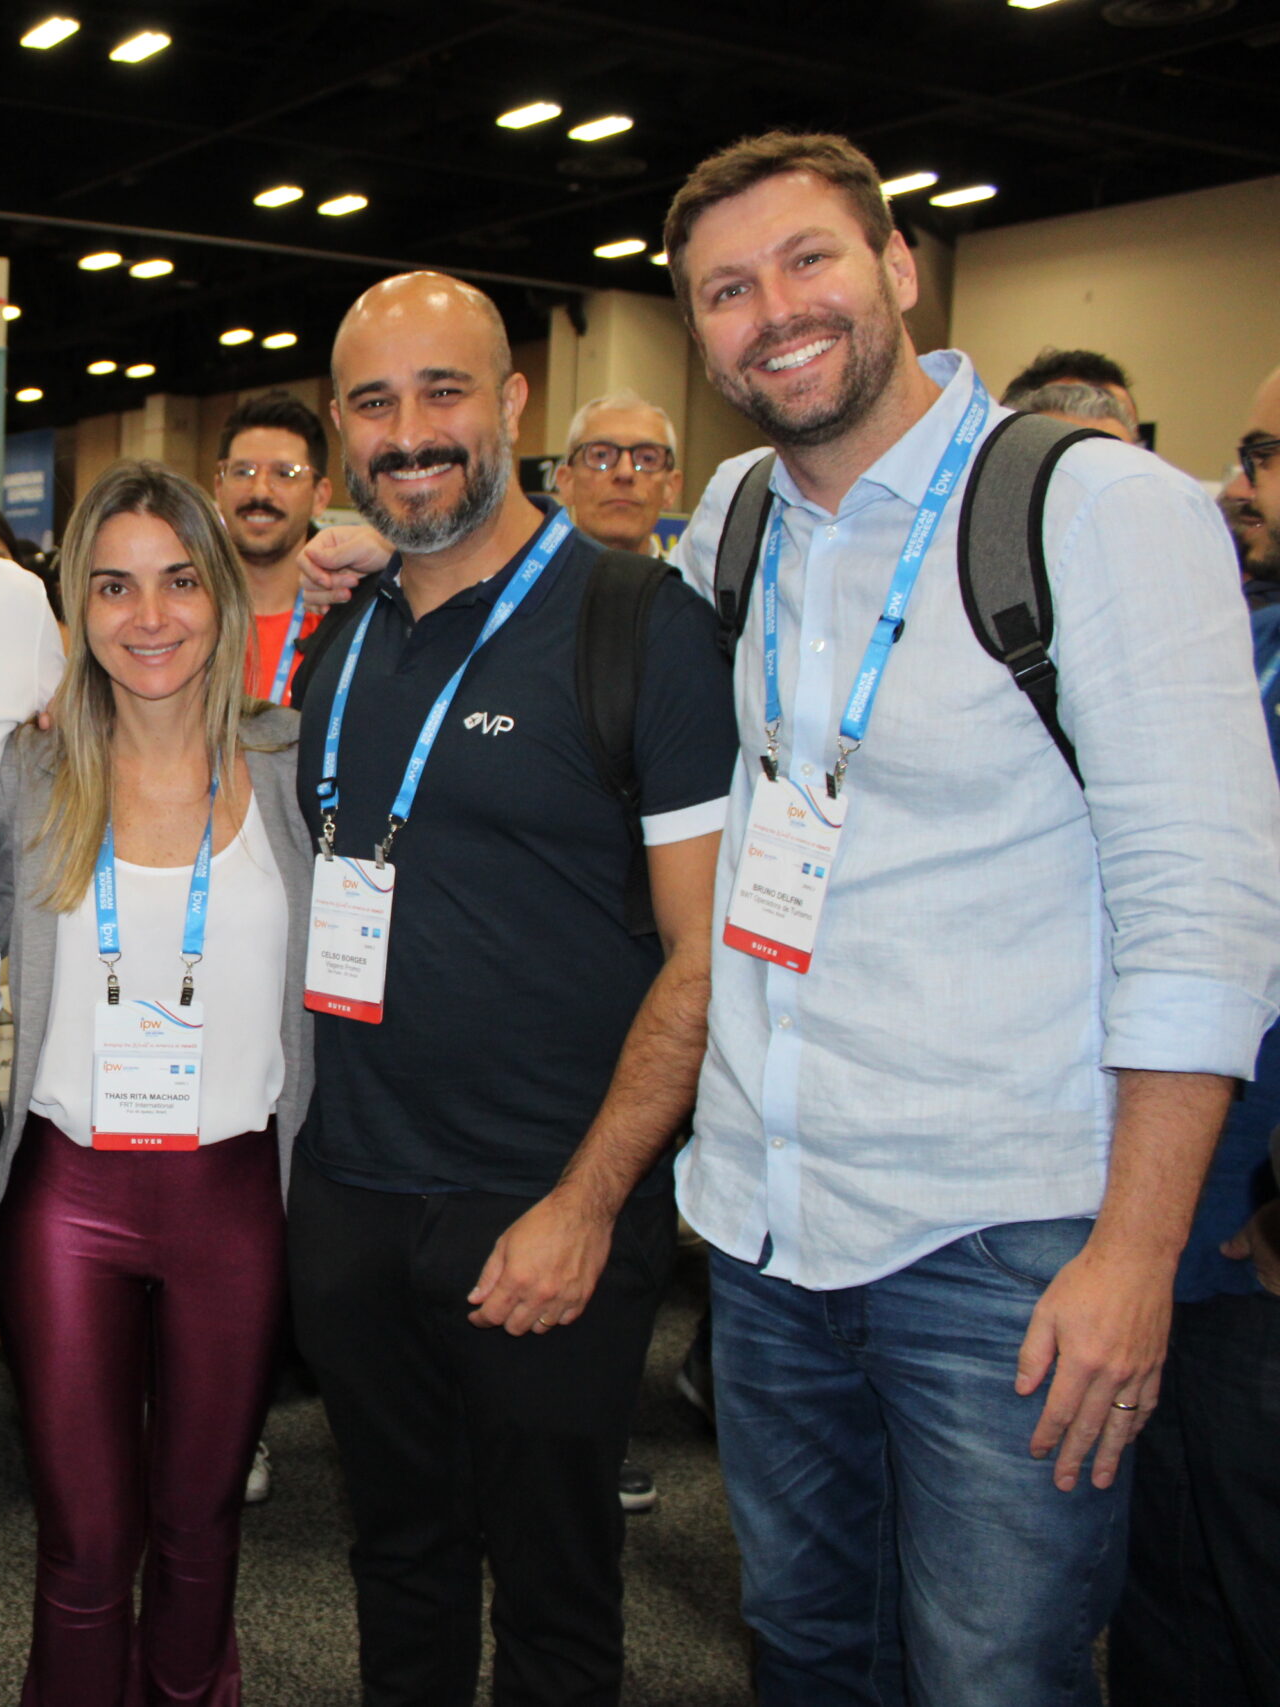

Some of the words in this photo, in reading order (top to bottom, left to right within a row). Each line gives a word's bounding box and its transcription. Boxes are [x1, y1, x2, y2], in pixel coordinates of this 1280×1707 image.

[927, 469, 953, 496] ipw
[902, 508, 930, 563] AMERICAN
[911, 511, 938, 558] EXPRESS
[522, 559, 544, 582] ipw
[853, 667, 878, 722] AMERICAN
[482, 711, 515, 737] VP
[787, 802, 807, 819] ipw
[191, 890, 208, 914] ipw
[752, 883, 777, 898] BRUNO
[100, 923, 117, 947] ipw
[140, 1017, 162, 1032] ipw
[104, 1092, 128, 1100] THAIS
[130, 1093, 148, 1101] RITA
[149, 1093, 190, 1101] MACHADO
[130, 1137, 163, 1145] BUYER
